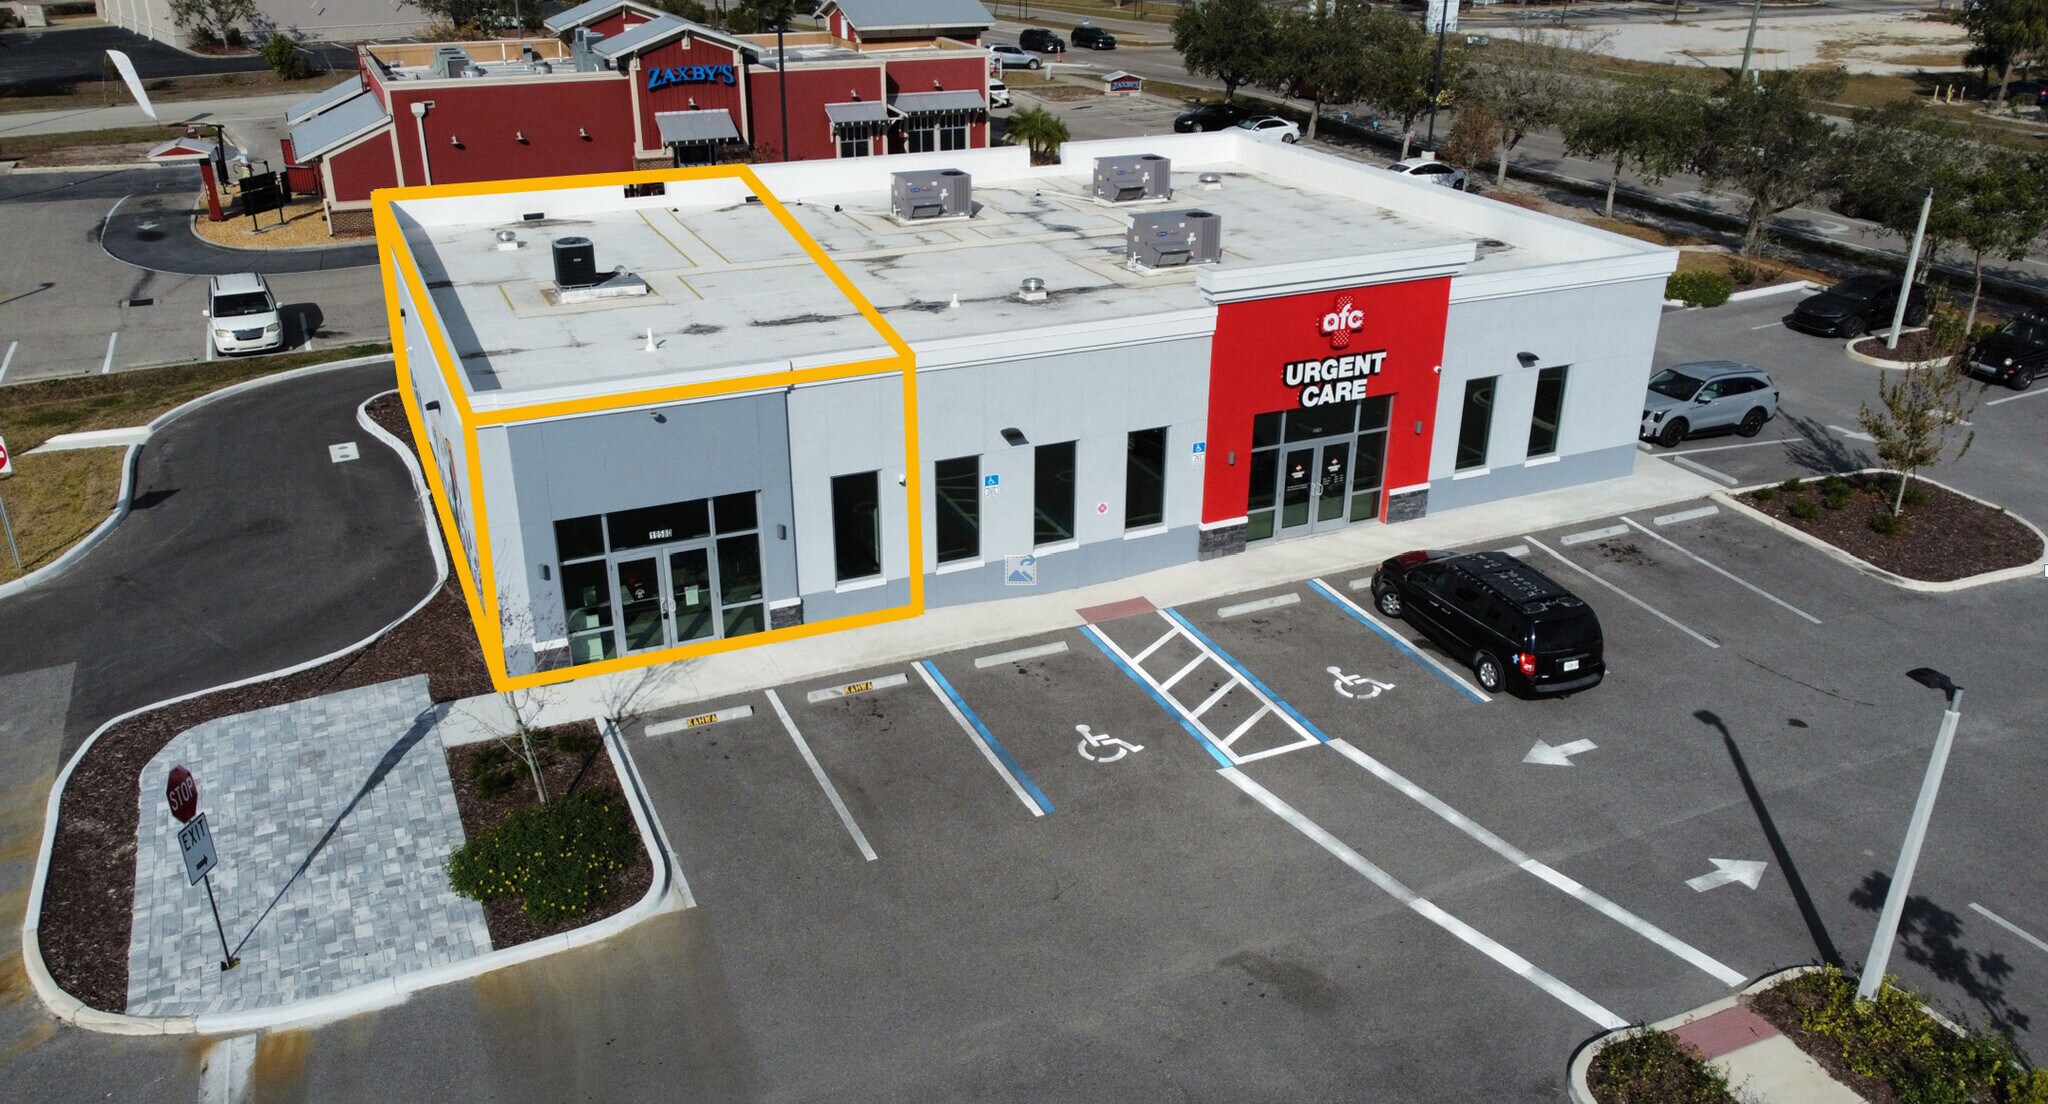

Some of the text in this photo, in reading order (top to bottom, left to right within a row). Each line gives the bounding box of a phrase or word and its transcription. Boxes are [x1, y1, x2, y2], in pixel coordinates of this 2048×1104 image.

[647, 64, 734, 89] ZAXBY'S
[1322, 303, 1364, 332] afc
[1285, 351, 1387, 386] URGENT
[1301, 378, 1368, 408] CARE
[843, 681, 873, 695] KAHWA
[686, 713, 718, 727] KAHWA
[169, 777, 193, 811] STOP
[182, 819, 206, 852] EXIT
